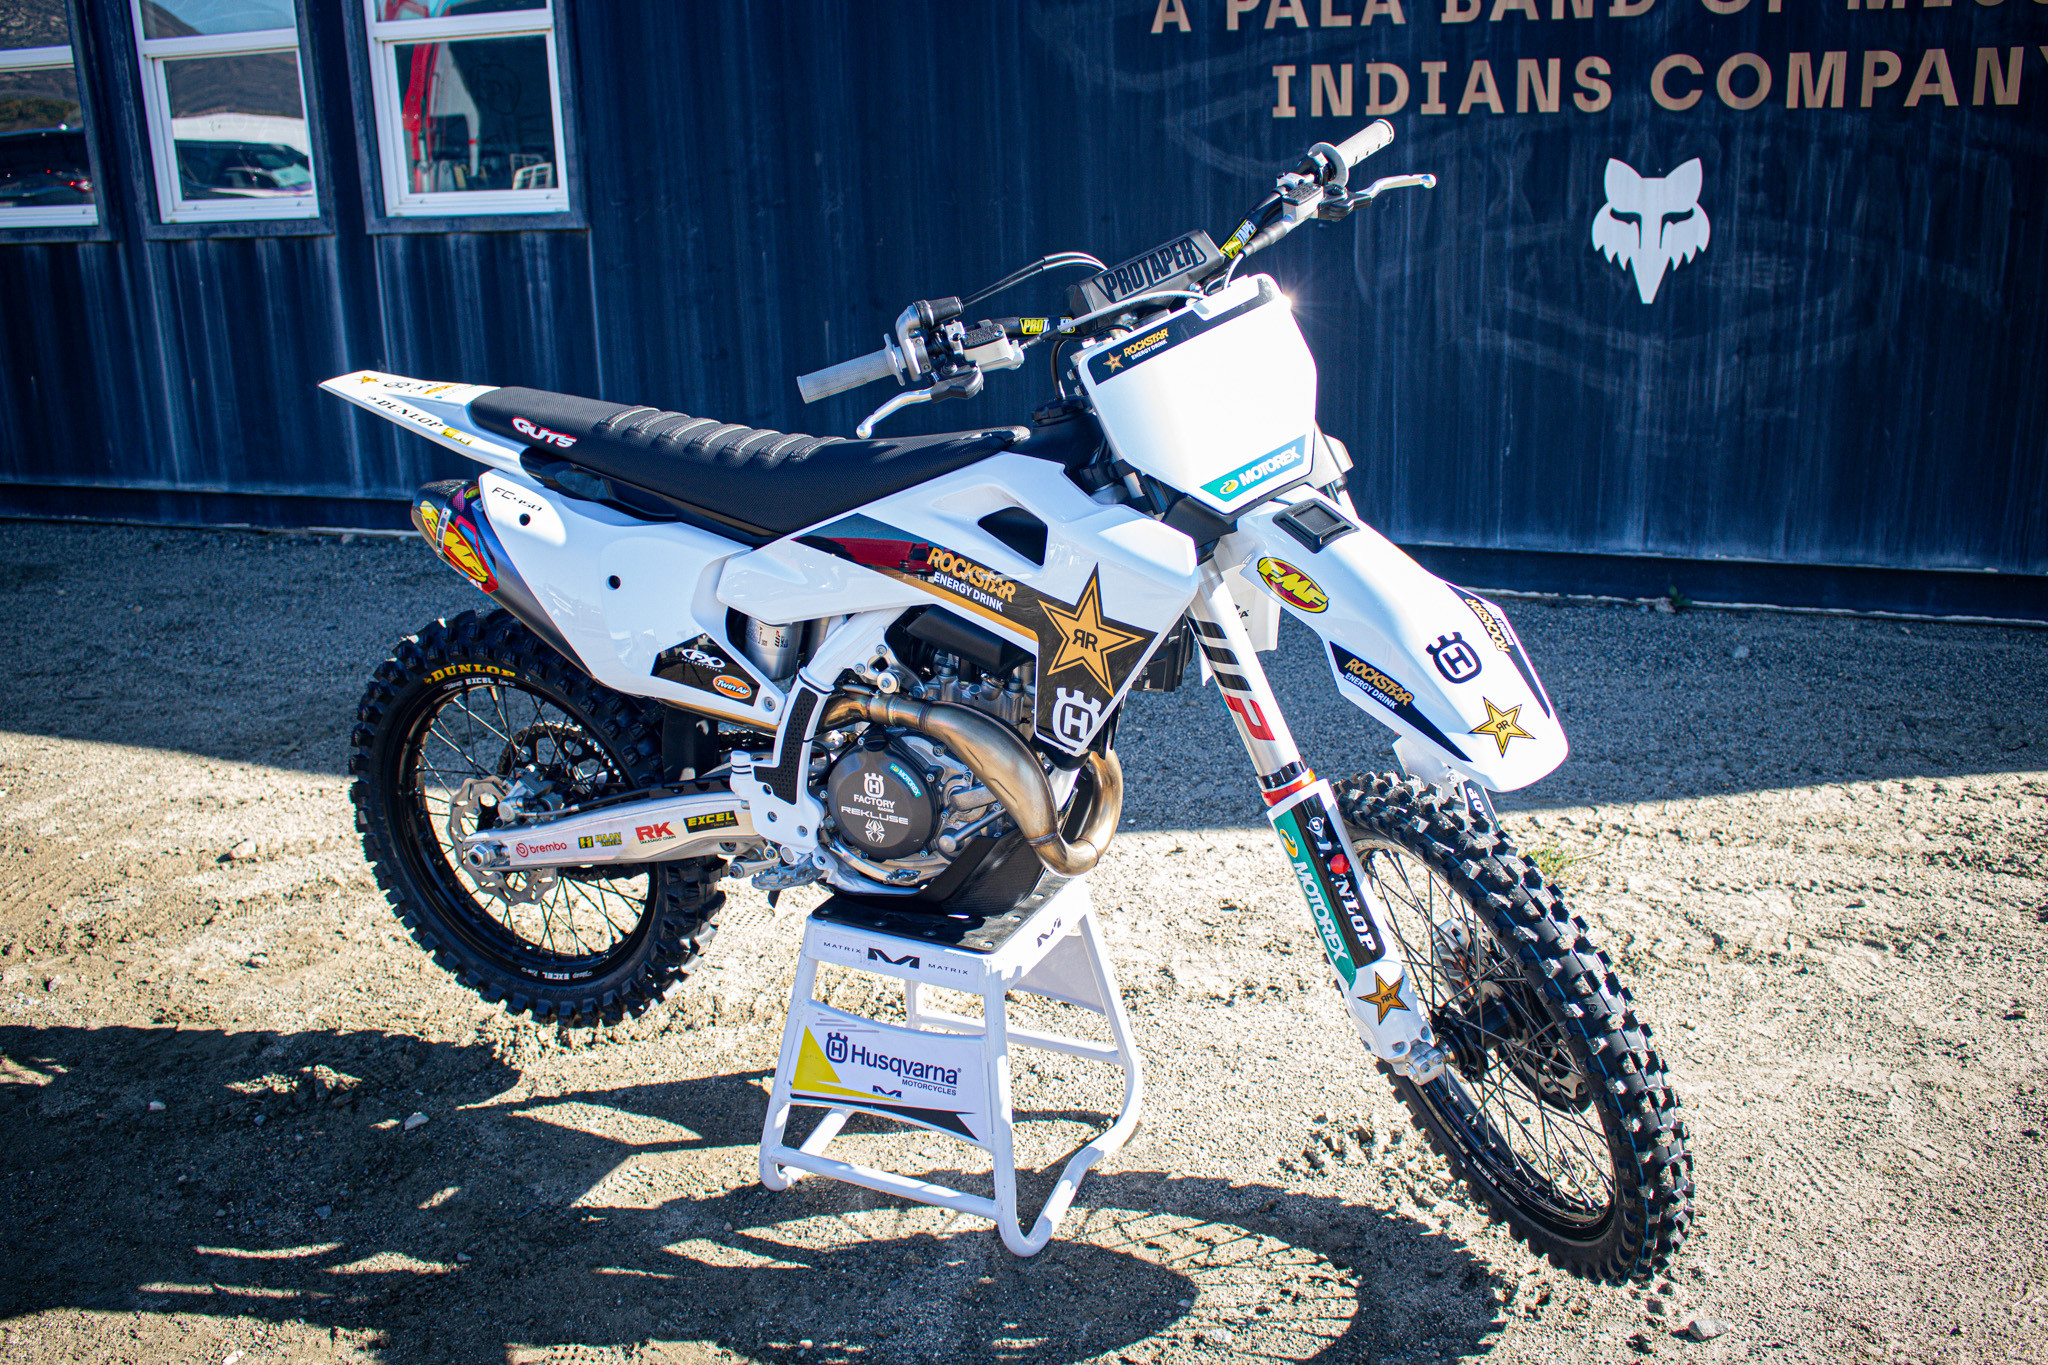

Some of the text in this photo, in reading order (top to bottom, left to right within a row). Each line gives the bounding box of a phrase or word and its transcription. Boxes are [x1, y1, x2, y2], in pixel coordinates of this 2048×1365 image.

[1272, 46, 2048, 118] INDIANS COMPAN
[1224, 221, 1257, 258] PROTAPE
[1102, 238, 1199, 301] PROTAPER
[1124, 328, 1169, 357] ROCKSTAR
[1131, 339, 1168, 360] ENERGY DRINK
[377, 400, 443, 428] DUNLOP
[512, 417, 577, 448] GUTS
[1238, 446, 1302, 487] MOTOREX
[926, 547, 1016, 603] ROCKSTAR
[1257, 559, 1330, 607] FMF
[934, 571, 1003, 612] ENERGY DRINK
[1465, 598, 1511, 652] ROCKSTAR
[431, 664, 516, 683] DUNLOP
[465, 677, 495, 686] EXCEL
[717, 679, 750, 695] Twin Air
[1345, 658, 1414, 706] ROCKSTAR
[1345, 672, 1398, 710] ENERGY DRINK
[898, 770, 920, 796] MOTOREX
[841, 806, 909, 826] REKLUSE
[853, 794, 895, 809] FACTORY
[635, 821, 675, 842] RK
[687, 811, 735, 827] EXCEL
[530, 841, 567, 855] brembo
[595, 832, 622, 843] HAAN
[1293, 861, 1349, 961] MOTOREX
[1316, 841, 1377, 951] NLOP
[823, 942, 861, 954] MATRIX
[928, 963, 969, 975] MATRIX
[542, 971, 570, 980] EXCEL
[851, 1043, 958, 1085] Husqvarna
[902, 1079, 957, 1096] MOTORCYCLES
